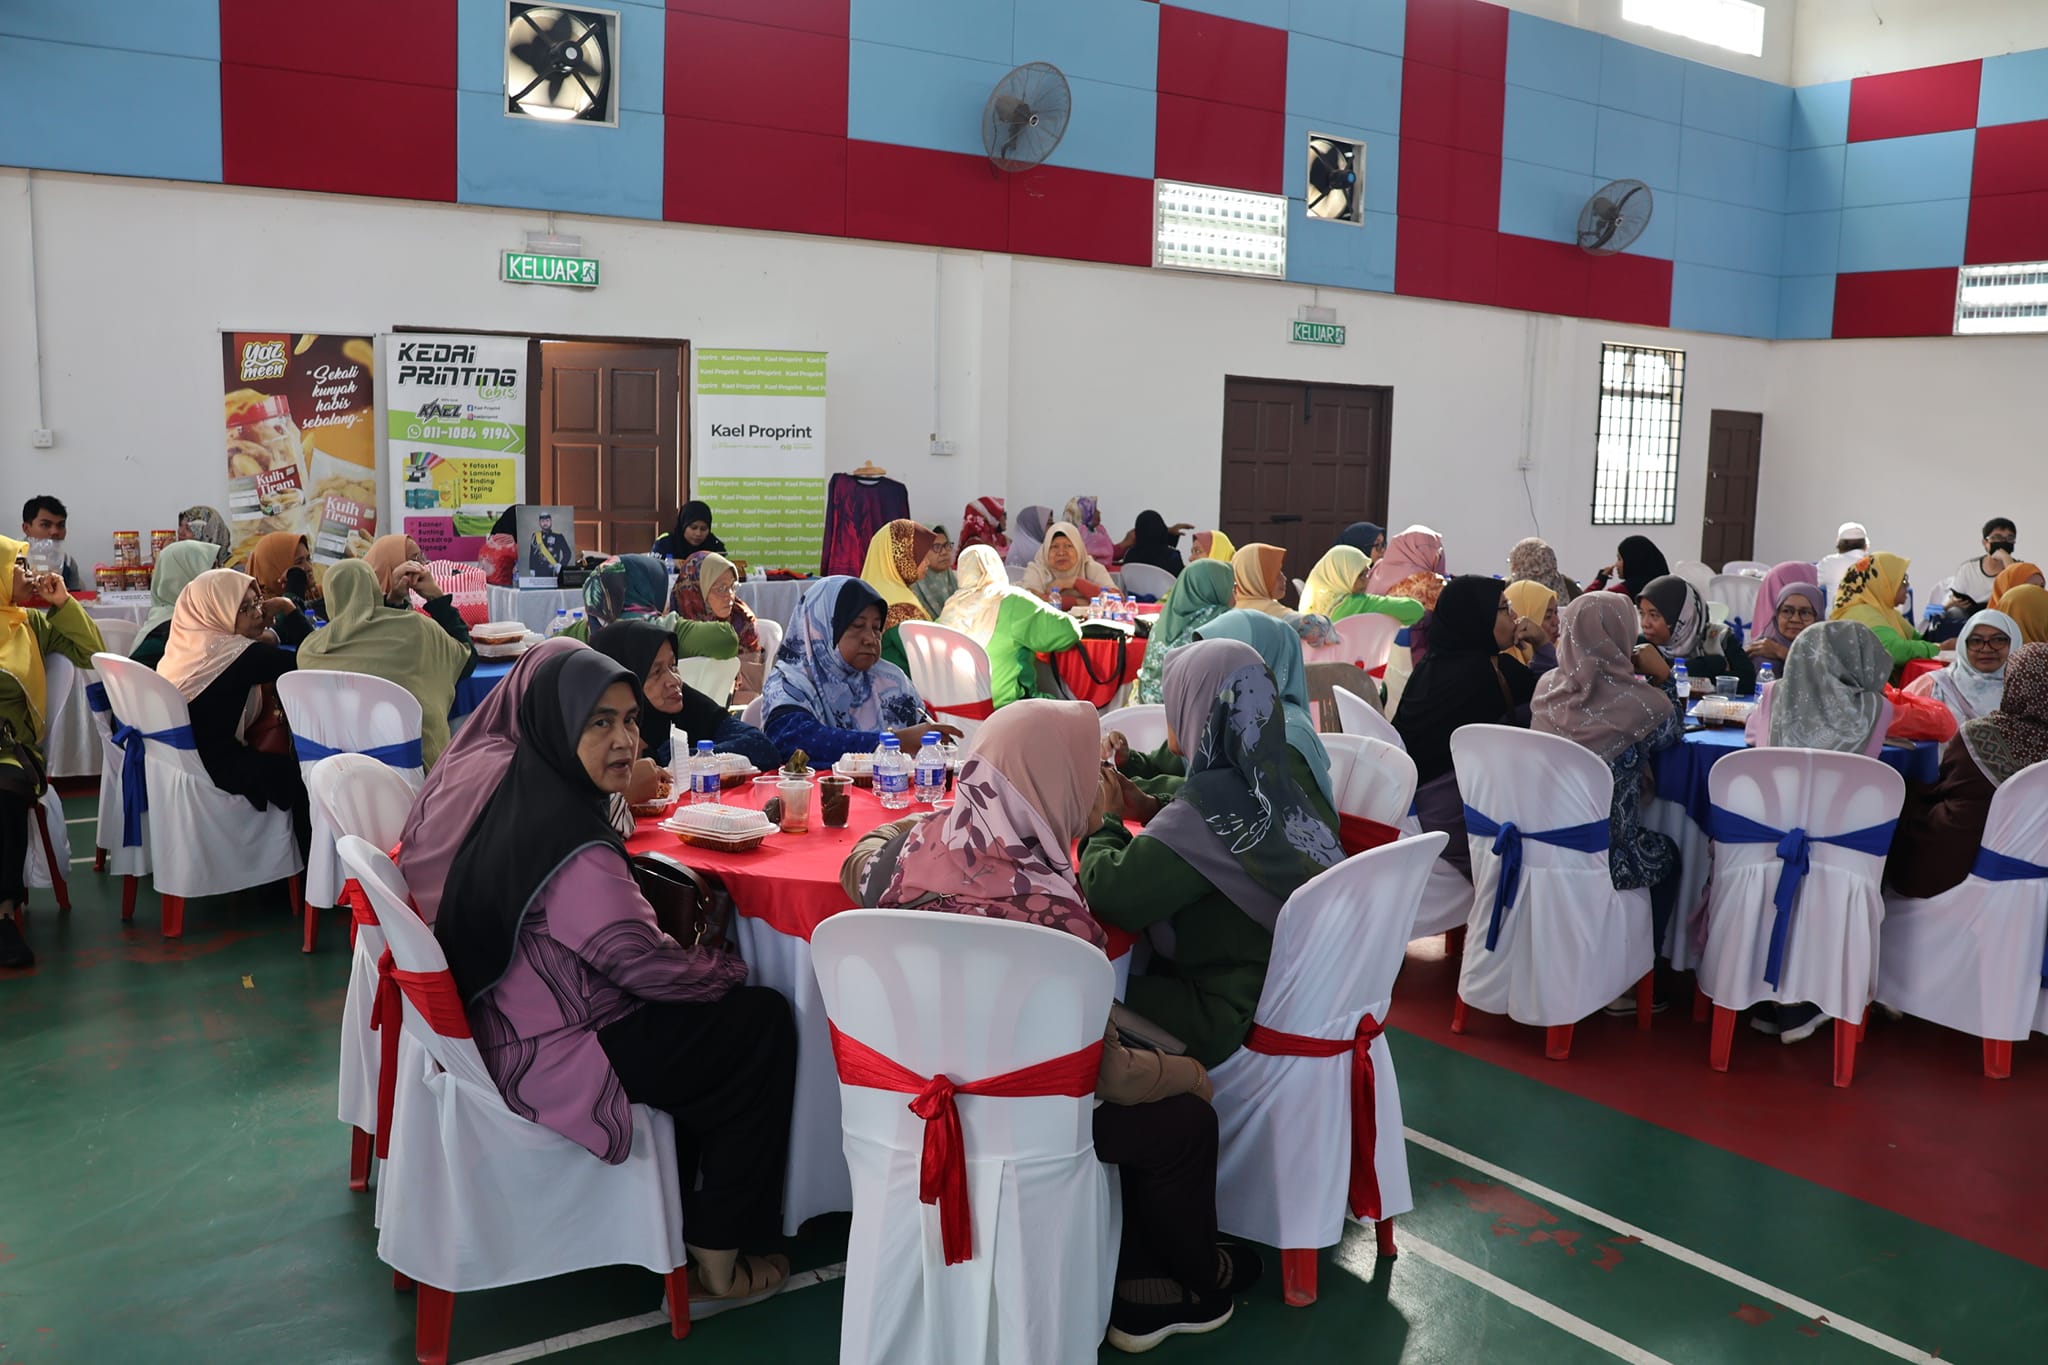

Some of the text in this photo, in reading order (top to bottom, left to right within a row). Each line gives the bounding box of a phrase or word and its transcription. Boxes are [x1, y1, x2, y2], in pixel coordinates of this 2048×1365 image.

[510, 255, 579, 282] KELUAR
[1295, 323, 1335, 343] KELUAR
[312, 381, 357, 400] kunyah
[315, 397, 351, 412] habis
[423, 426, 510, 440] 011-1084 9194
[711, 424, 812, 441] Kael Proprint
[326, 496, 360, 517] Kuih
[326, 508, 358, 527] Tiram
